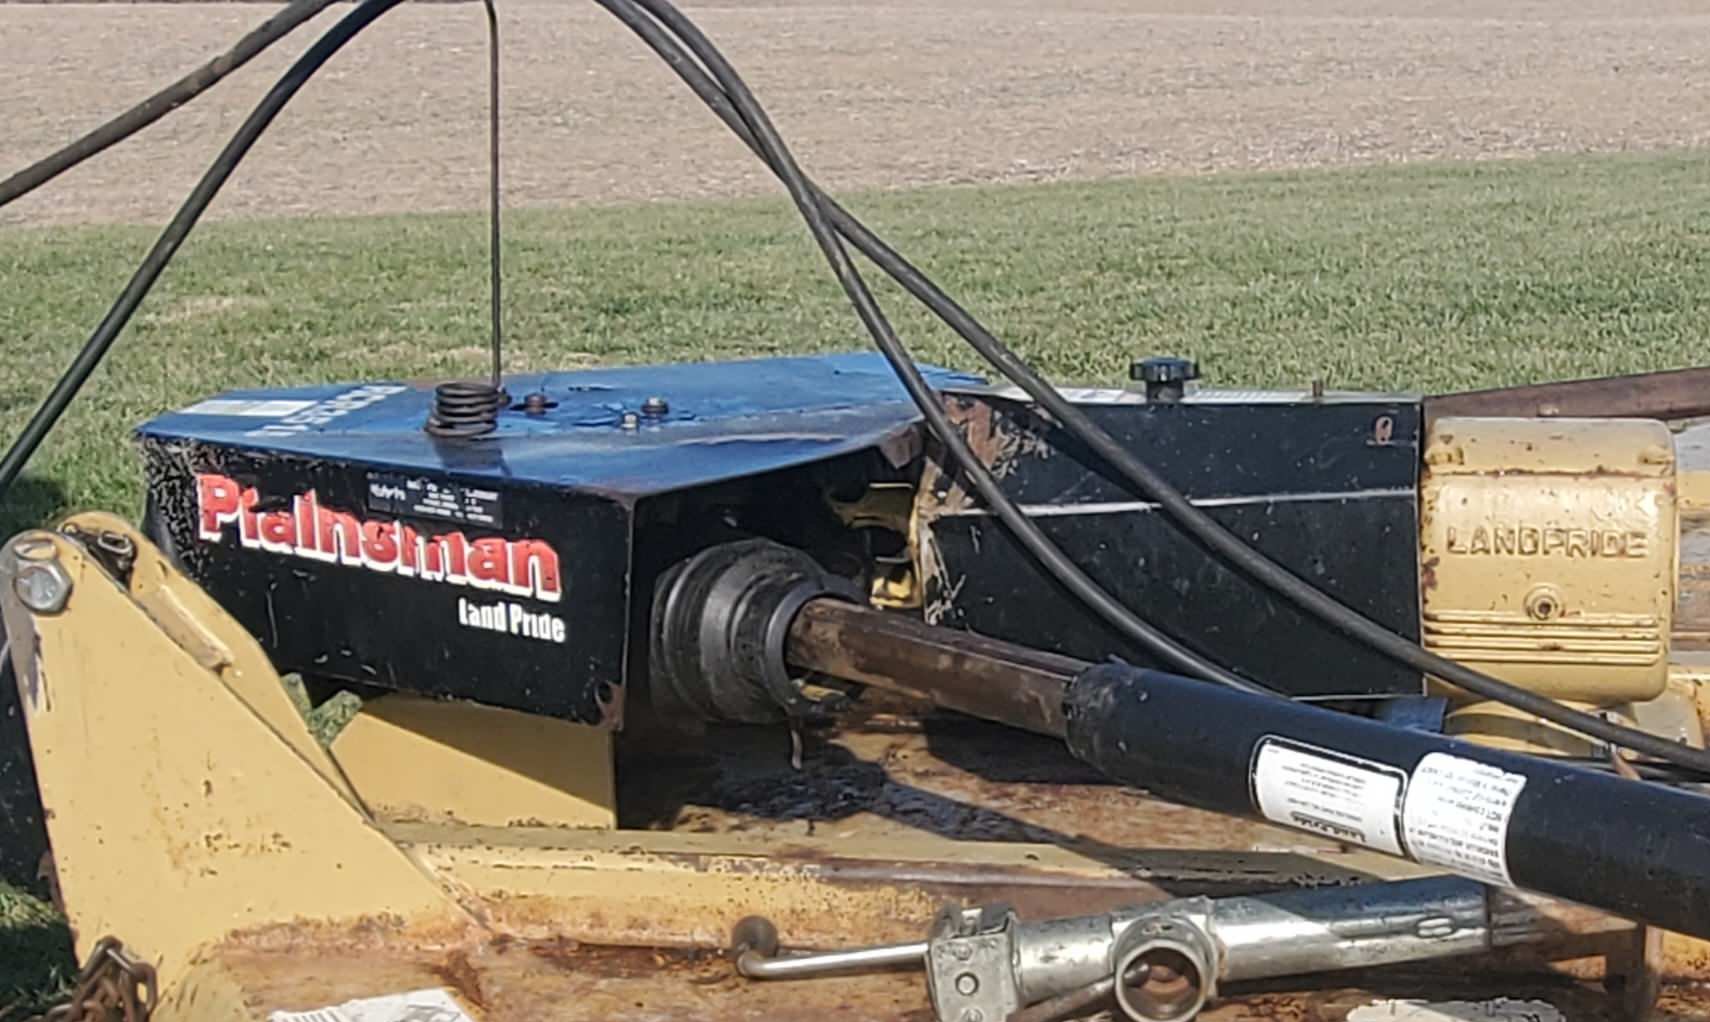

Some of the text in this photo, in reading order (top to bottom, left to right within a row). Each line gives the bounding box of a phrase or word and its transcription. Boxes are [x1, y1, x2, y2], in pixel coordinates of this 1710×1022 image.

[197, 473, 561, 602] Plainsman
[458, 597, 566, 643] Land Pride
